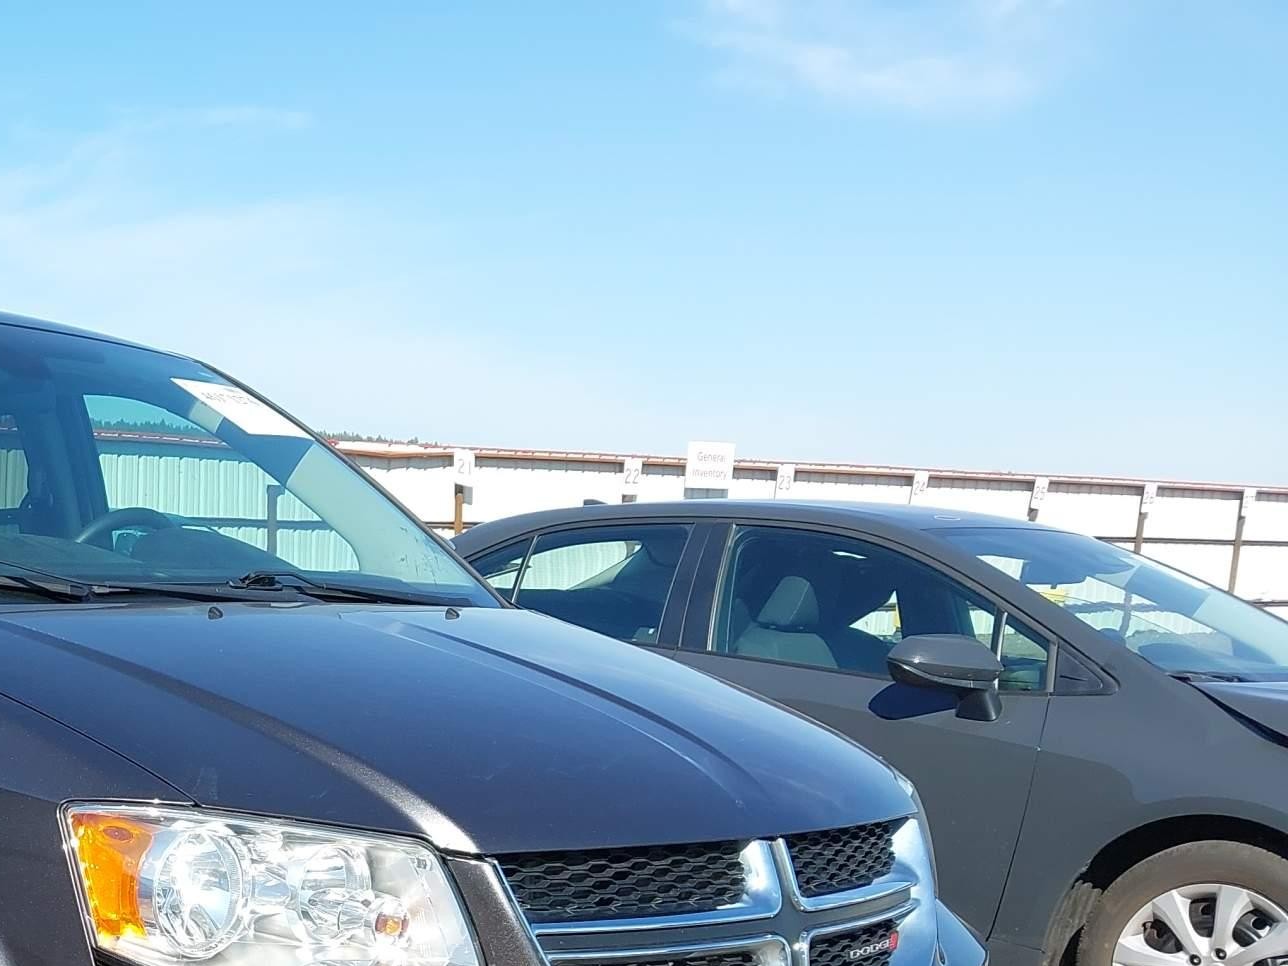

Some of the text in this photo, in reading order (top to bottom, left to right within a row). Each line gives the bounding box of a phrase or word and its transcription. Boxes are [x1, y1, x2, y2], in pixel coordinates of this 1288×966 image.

[697, 451, 727, 463] General
[457, 458, 472, 475] 21
[624, 468, 639, 484] 22
[778, 475, 792, 490] 23
[914, 480, 926, 495] 24
